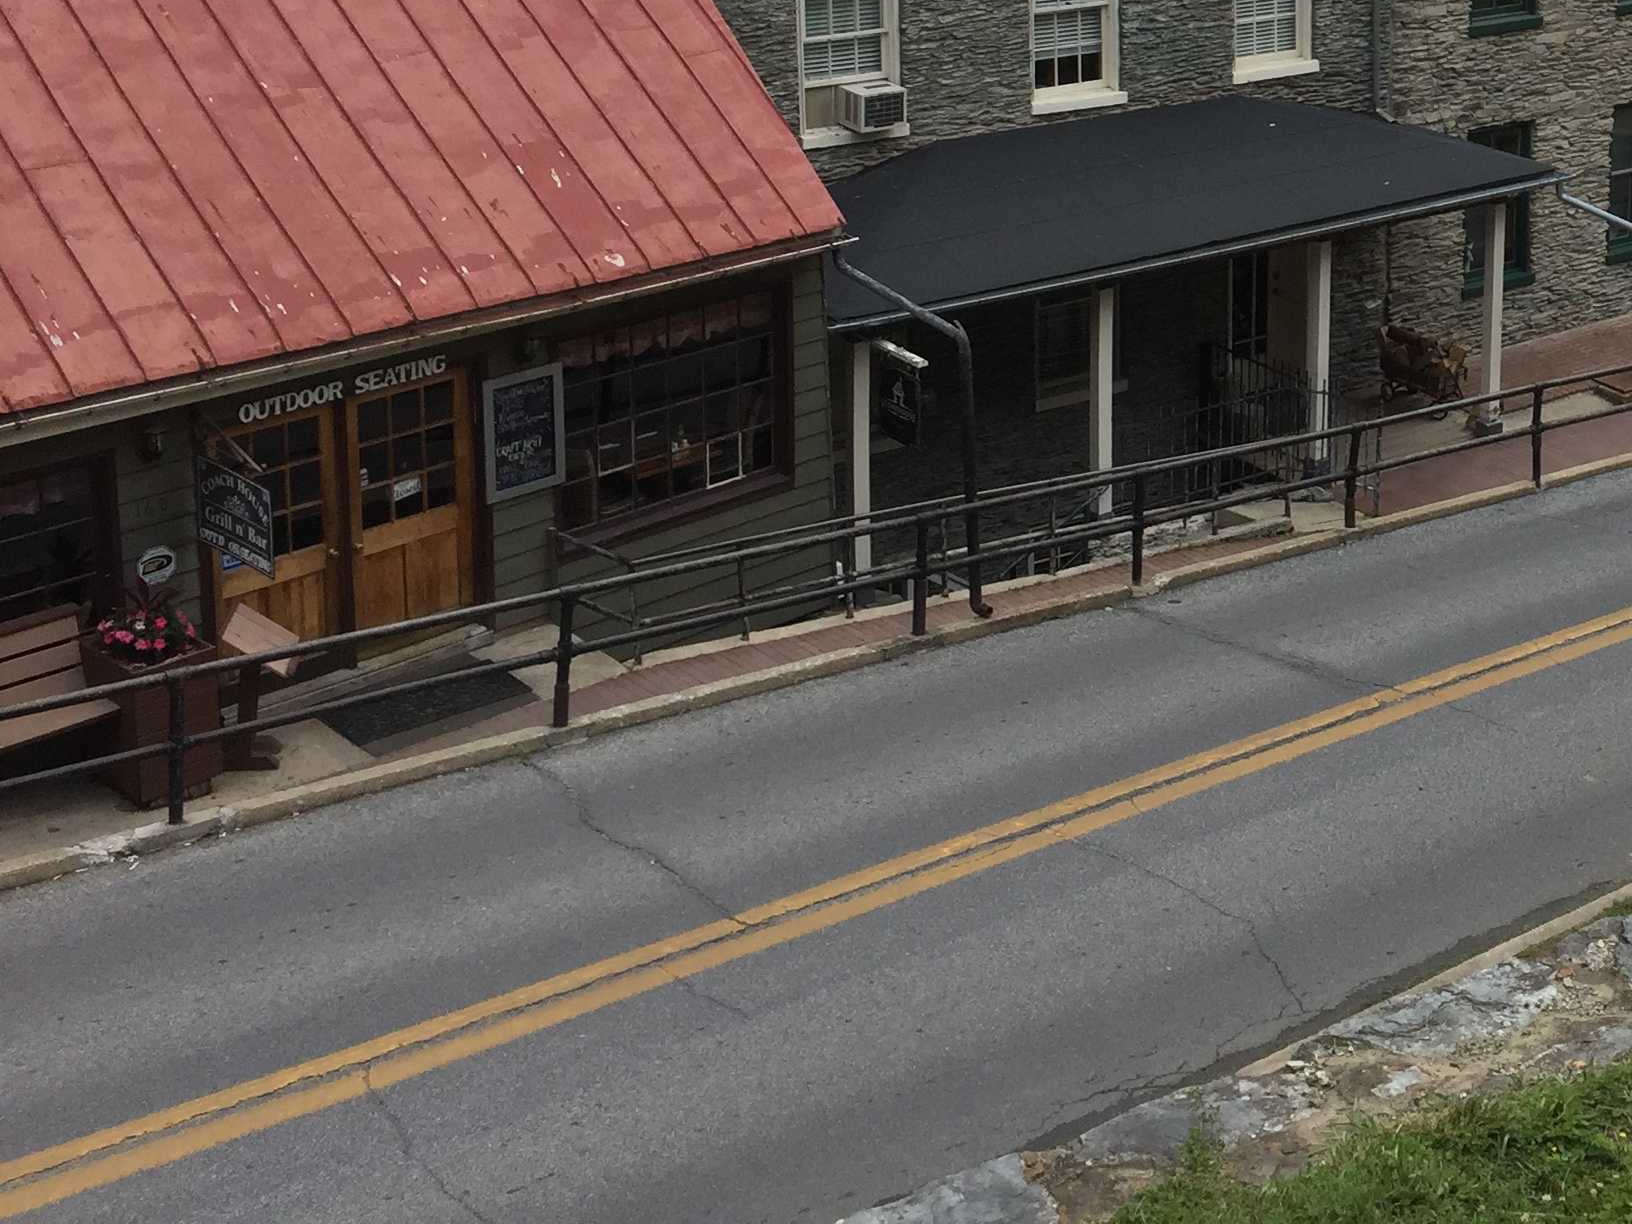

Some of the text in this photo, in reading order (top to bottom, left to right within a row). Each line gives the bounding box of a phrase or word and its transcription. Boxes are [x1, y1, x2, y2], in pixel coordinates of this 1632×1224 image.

[238, 354, 446, 424] OUTDOOR SEATING
[201, 475, 269, 527] COACH HOUSE
[205, 506, 232, 531] Grill
[248, 526, 268, 550] Bar
